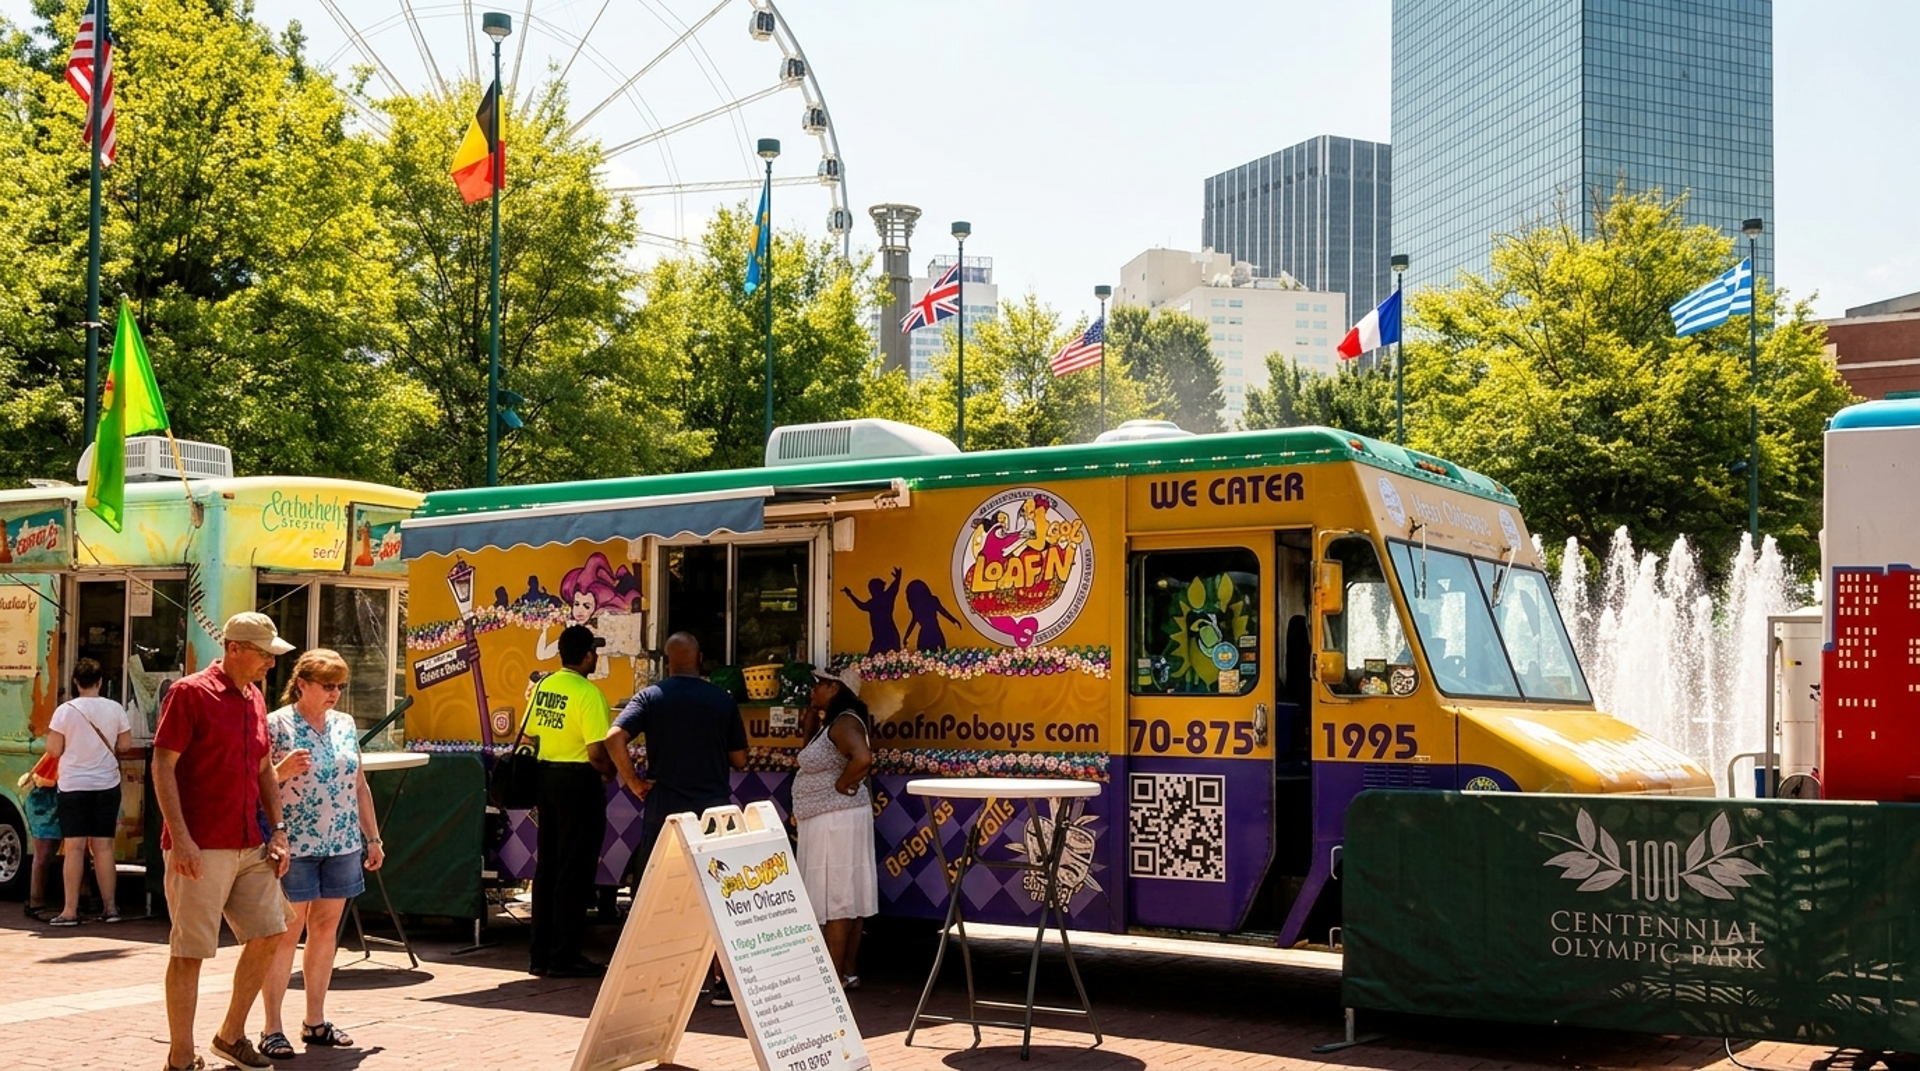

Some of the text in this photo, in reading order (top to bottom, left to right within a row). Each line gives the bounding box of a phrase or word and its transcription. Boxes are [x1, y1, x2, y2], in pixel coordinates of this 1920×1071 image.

[1151, 472, 1304, 510] WE CATER
[1045, 722, 1099, 743] com
[1322, 722, 1418, 760] 1995
[1626, 839, 1680, 902] 100
[1550, 910, 1765, 945] CENTENNIAL
[1551, 936, 1765, 969] OLYMPIC PARK
